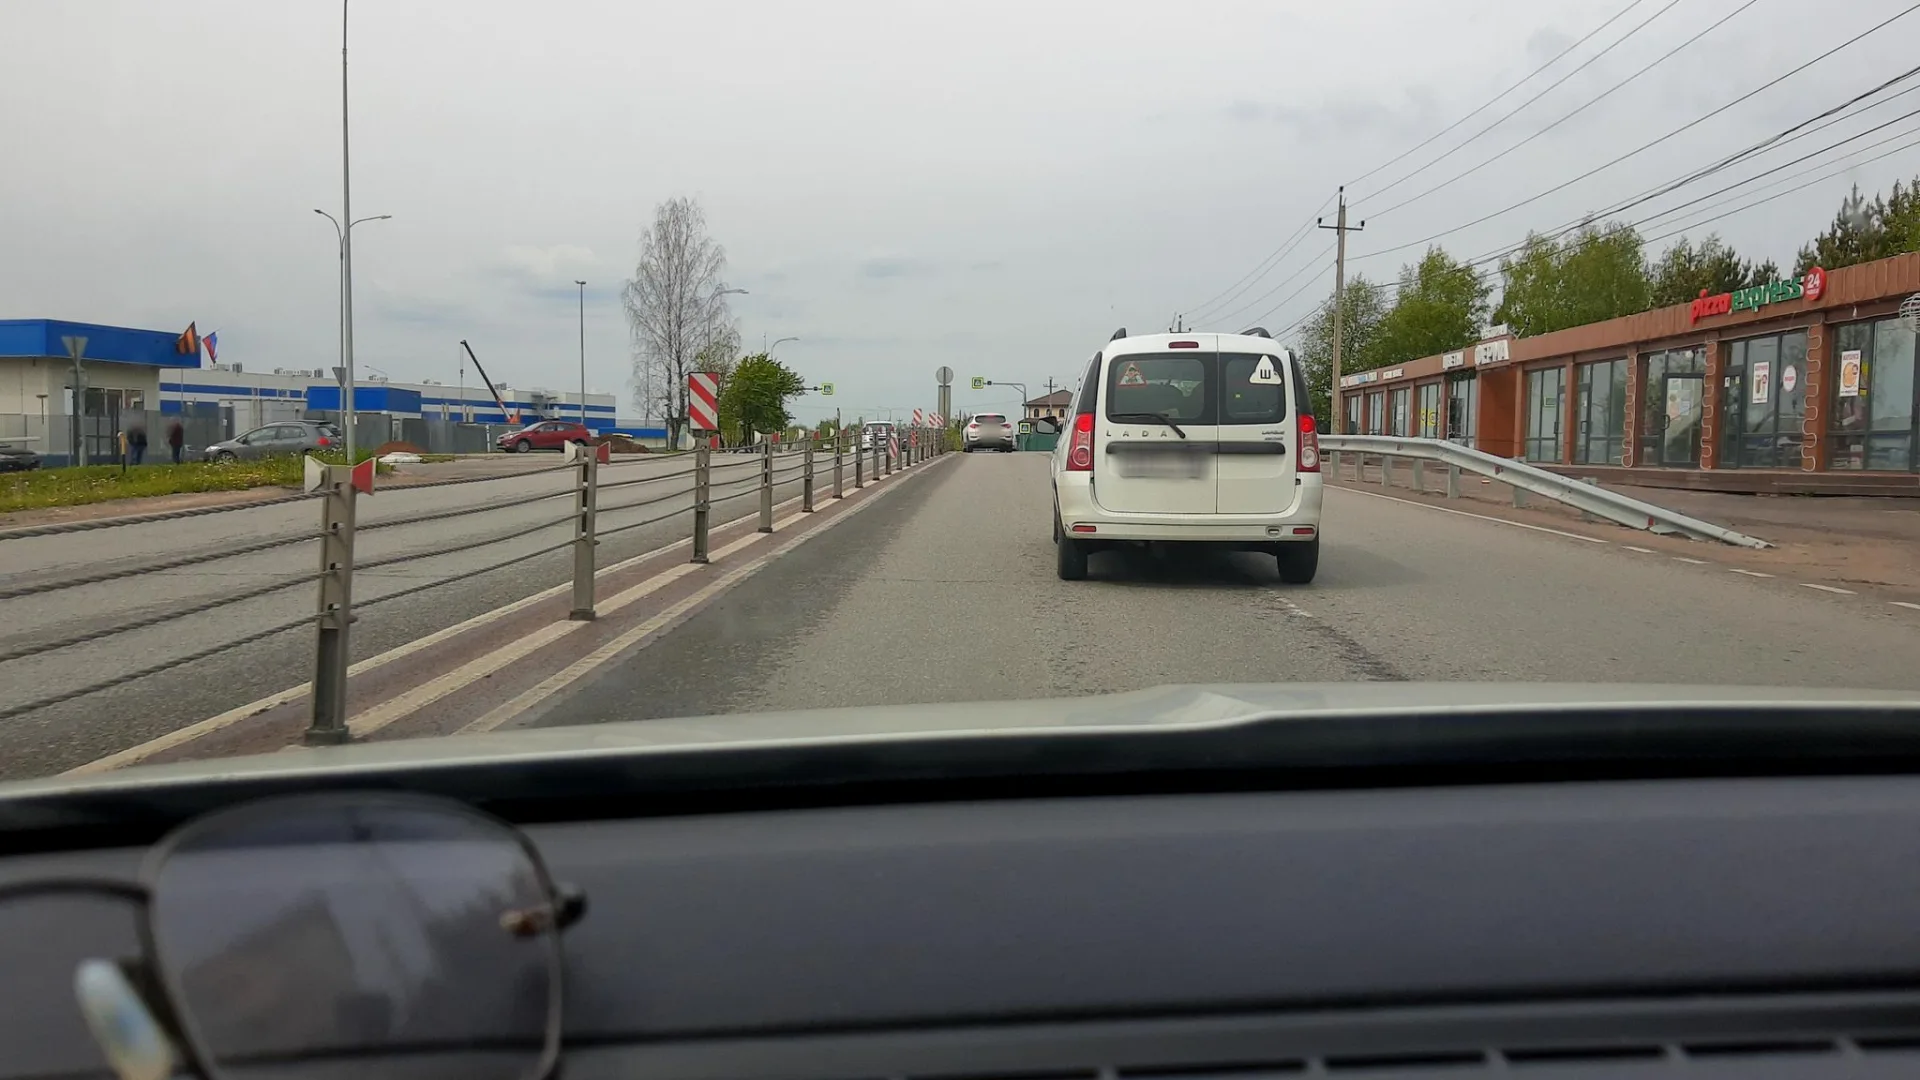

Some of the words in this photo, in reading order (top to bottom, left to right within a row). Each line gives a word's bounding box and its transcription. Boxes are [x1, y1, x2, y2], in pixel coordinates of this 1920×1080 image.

[1807, 273, 1820, 289] 24
[1691, 289, 1731, 324] pizza
[1732, 277, 1804, 312] express
[1260, 369, 1271, 379] Ш
[1106, 429, 1167, 437] LADA
